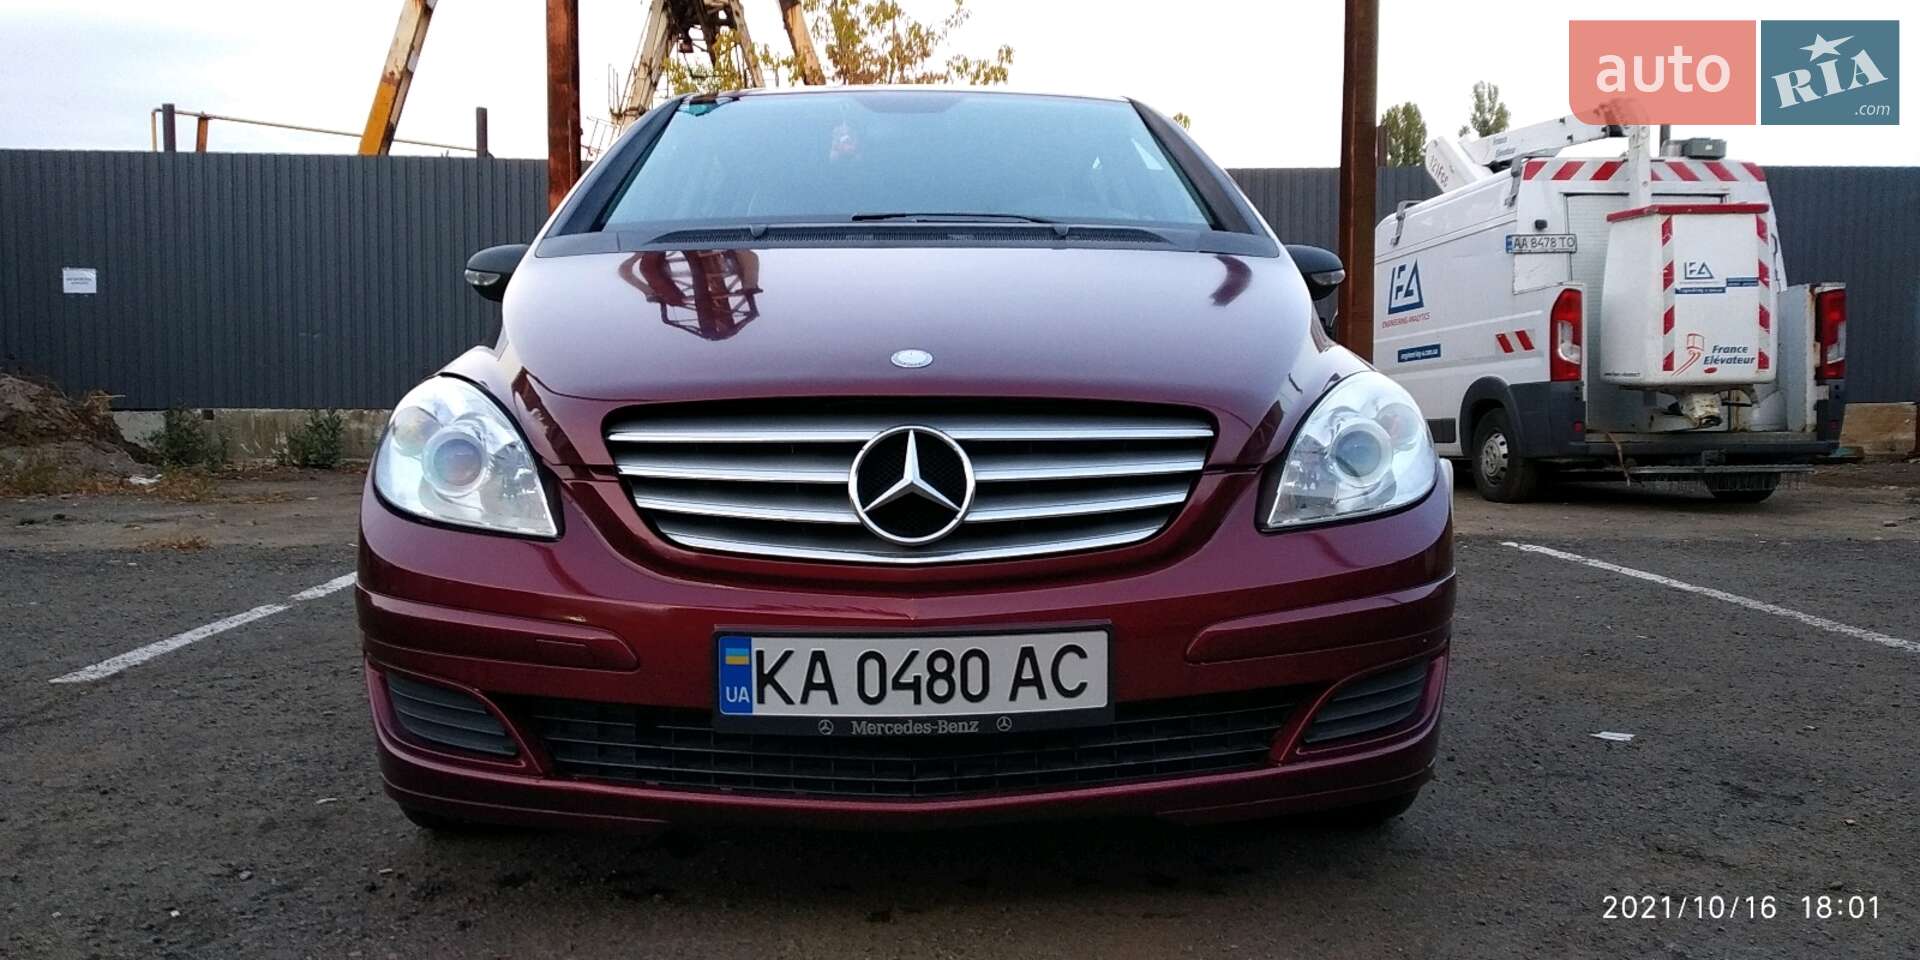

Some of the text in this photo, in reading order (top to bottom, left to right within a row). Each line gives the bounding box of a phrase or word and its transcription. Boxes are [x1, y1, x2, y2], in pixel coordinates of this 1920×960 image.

[1514, 236, 1576, 249] AA 8478 TO
[1712, 345, 1749, 354] France
[725, 644, 1089, 706] UA KA 0480 AC
[850, 719, 979, 736] Mercedes-Benz
